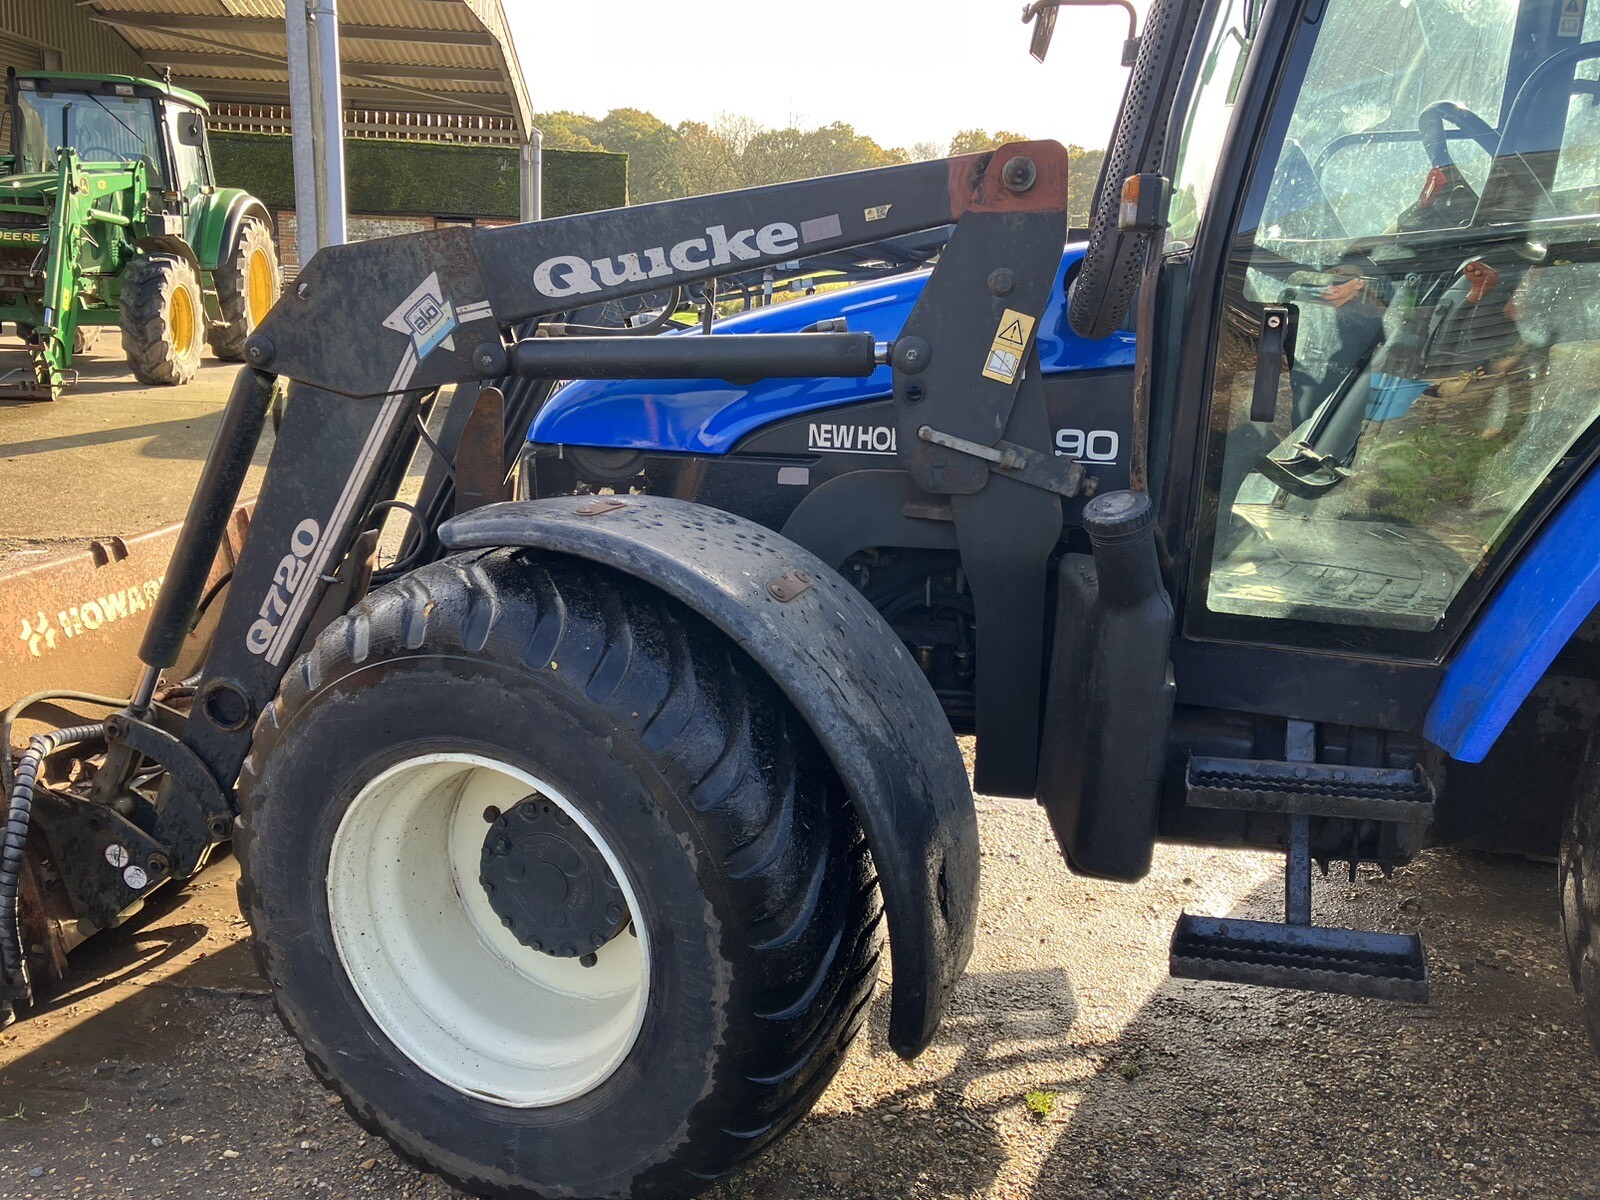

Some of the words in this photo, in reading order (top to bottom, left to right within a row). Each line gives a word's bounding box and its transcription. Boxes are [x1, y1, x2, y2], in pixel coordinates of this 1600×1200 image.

[533, 222, 799, 298] Quicke
[808, 423, 855, 449] NEW
[1054, 428, 1119, 461] 90
[57, 575, 165, 639] HOWAR
[246, 518, 320, 655] Q720
